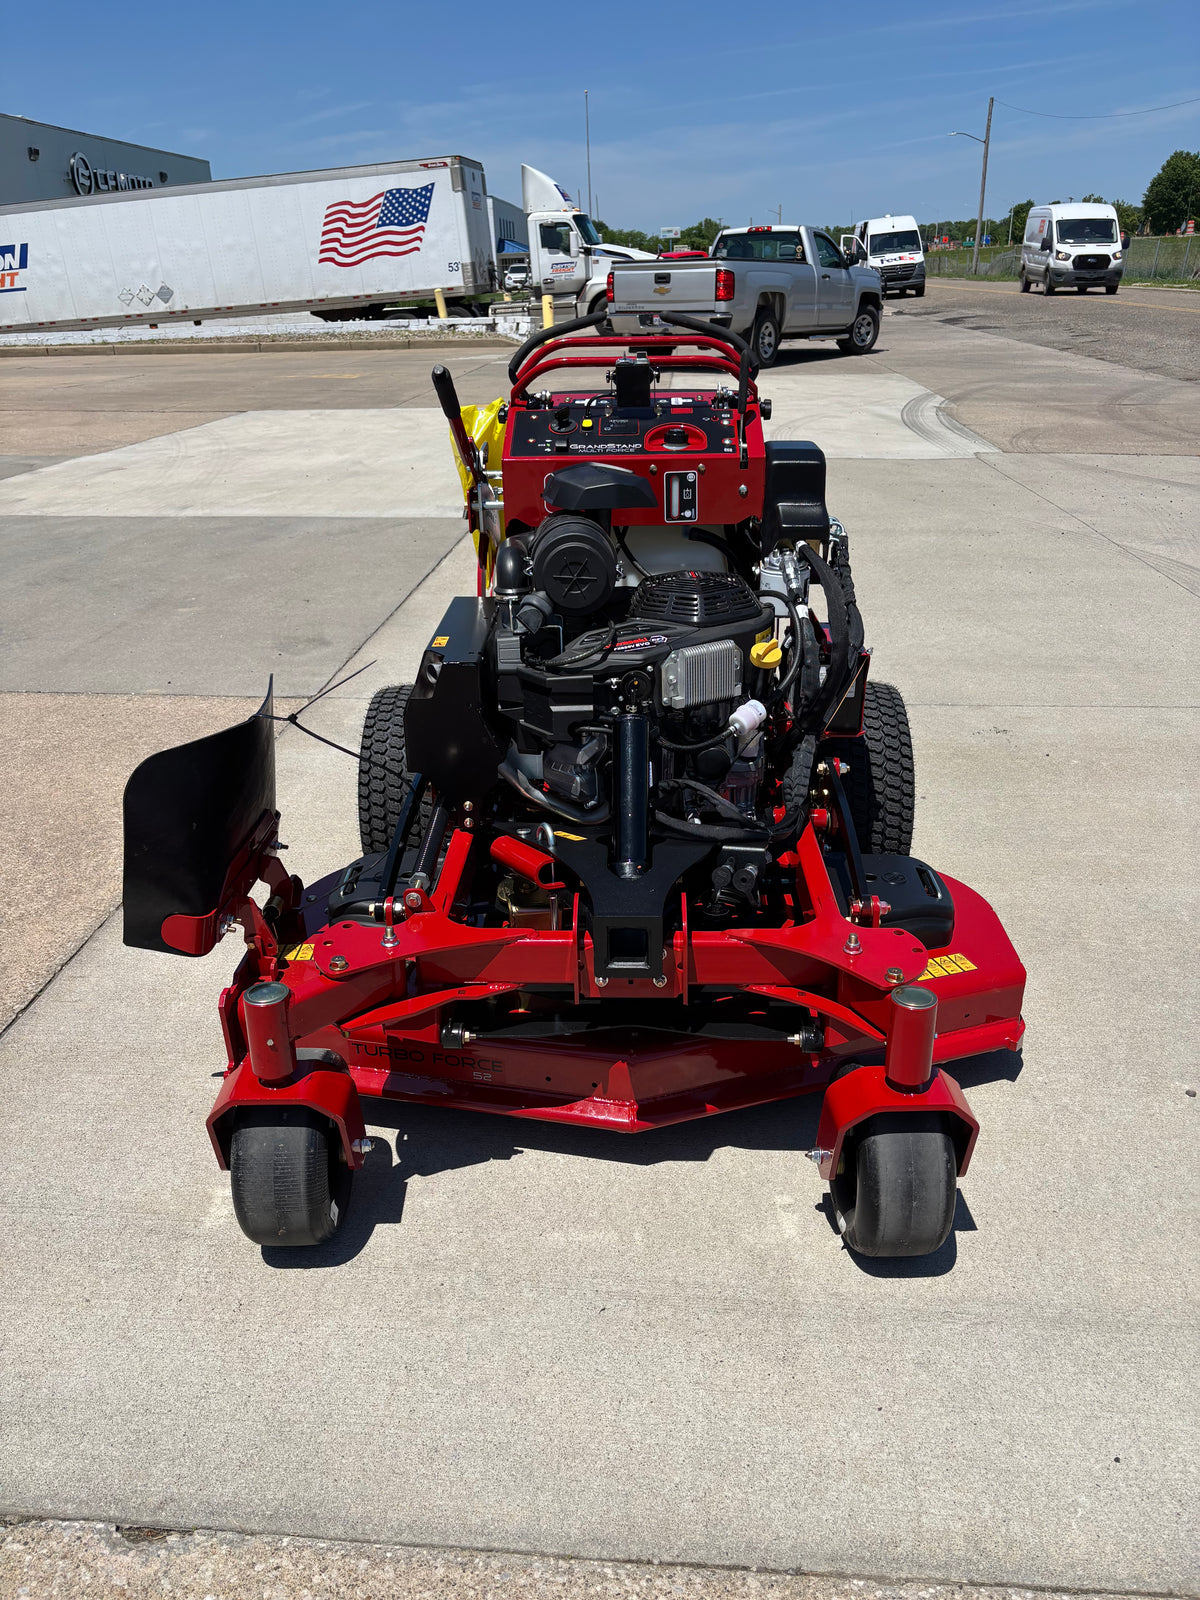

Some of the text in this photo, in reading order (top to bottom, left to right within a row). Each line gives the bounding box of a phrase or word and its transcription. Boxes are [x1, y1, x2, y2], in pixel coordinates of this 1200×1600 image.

[880, 255, 916, 265] FedEx
[351, 1042, 503, 1073] TURBO FORCE
[472, 1071, 493, 1082] 52
